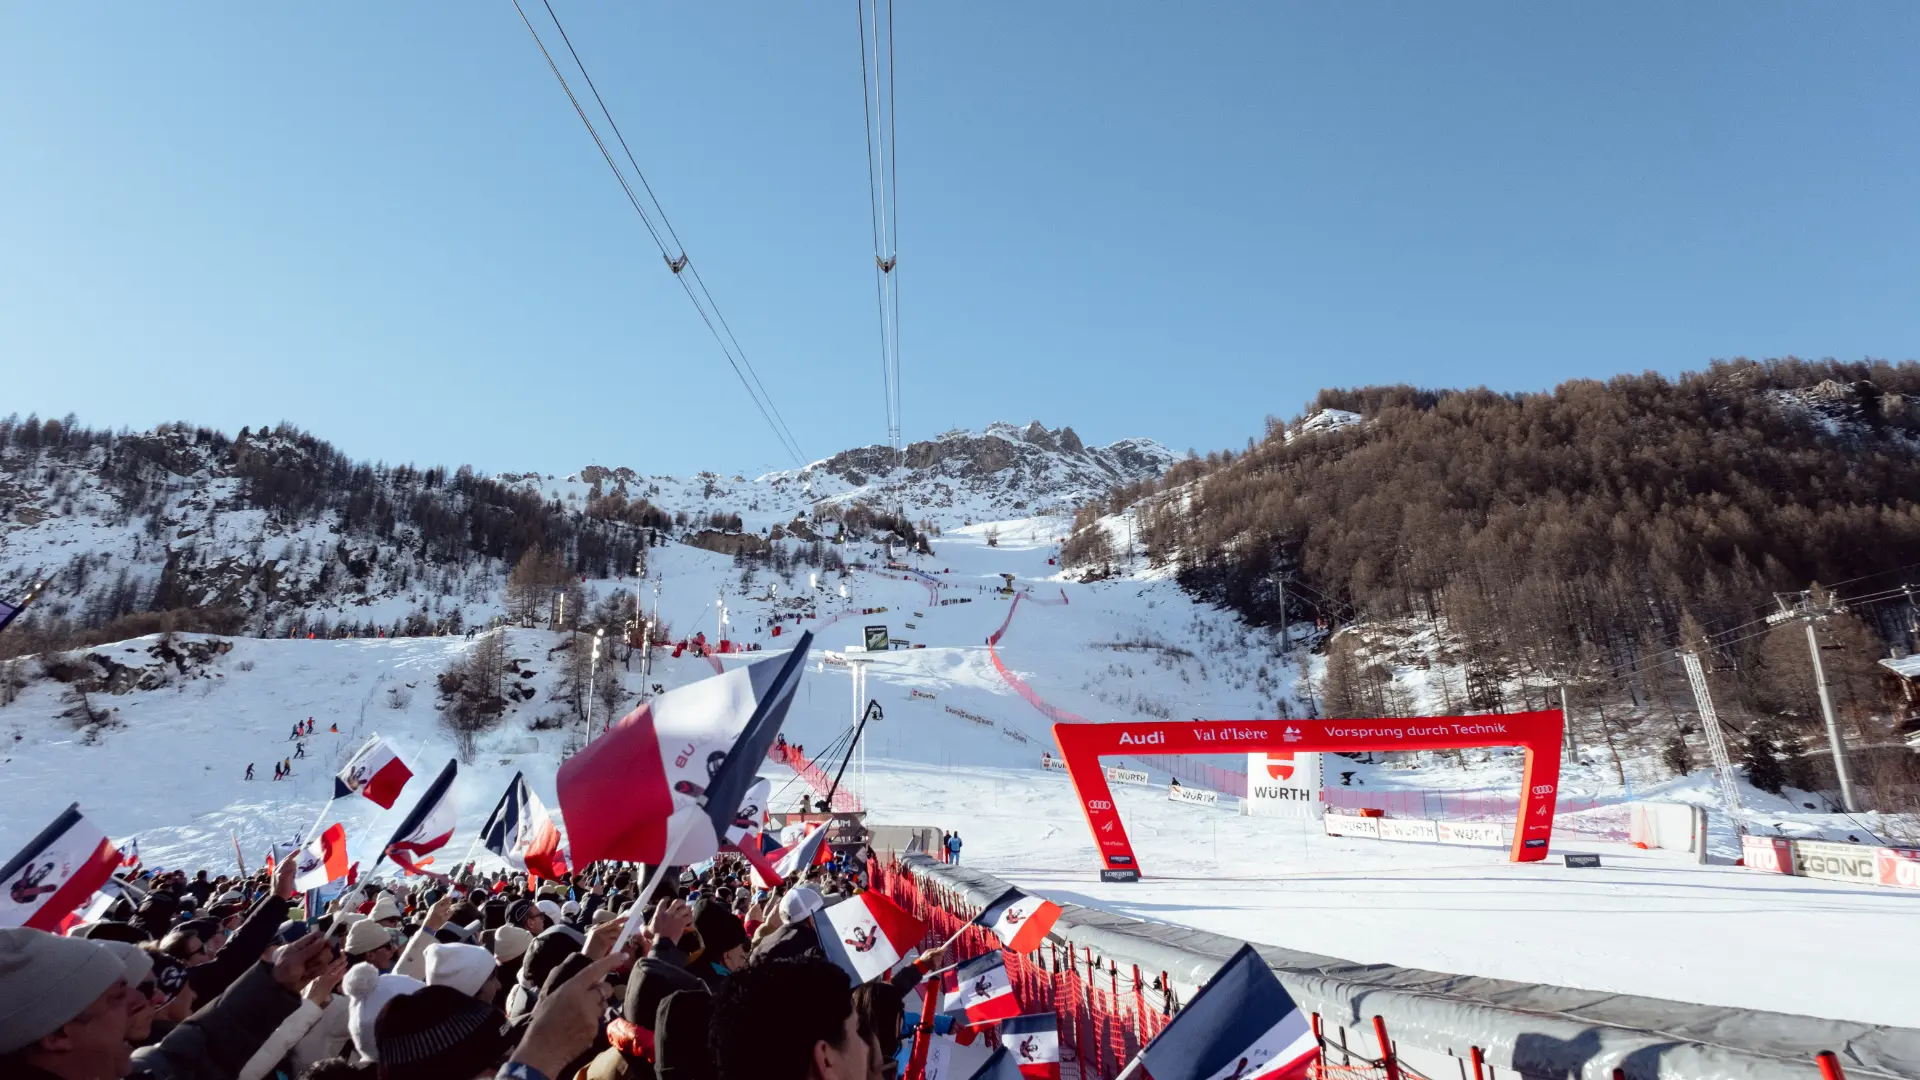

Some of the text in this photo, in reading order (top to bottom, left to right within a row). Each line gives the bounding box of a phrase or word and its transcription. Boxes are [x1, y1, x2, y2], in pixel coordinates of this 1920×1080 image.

[1119, 731, 1165, 745] Audi
[1193, 728, 1216, 741] Val
[1220, 727, 1268, 741] d'Isère
[1324, 722, 1507, 739] Vorsprung durch Technik
[1254, 786, 1310, 802] WÜRTH
[1796, 853, 1874, 878] ZGONC
